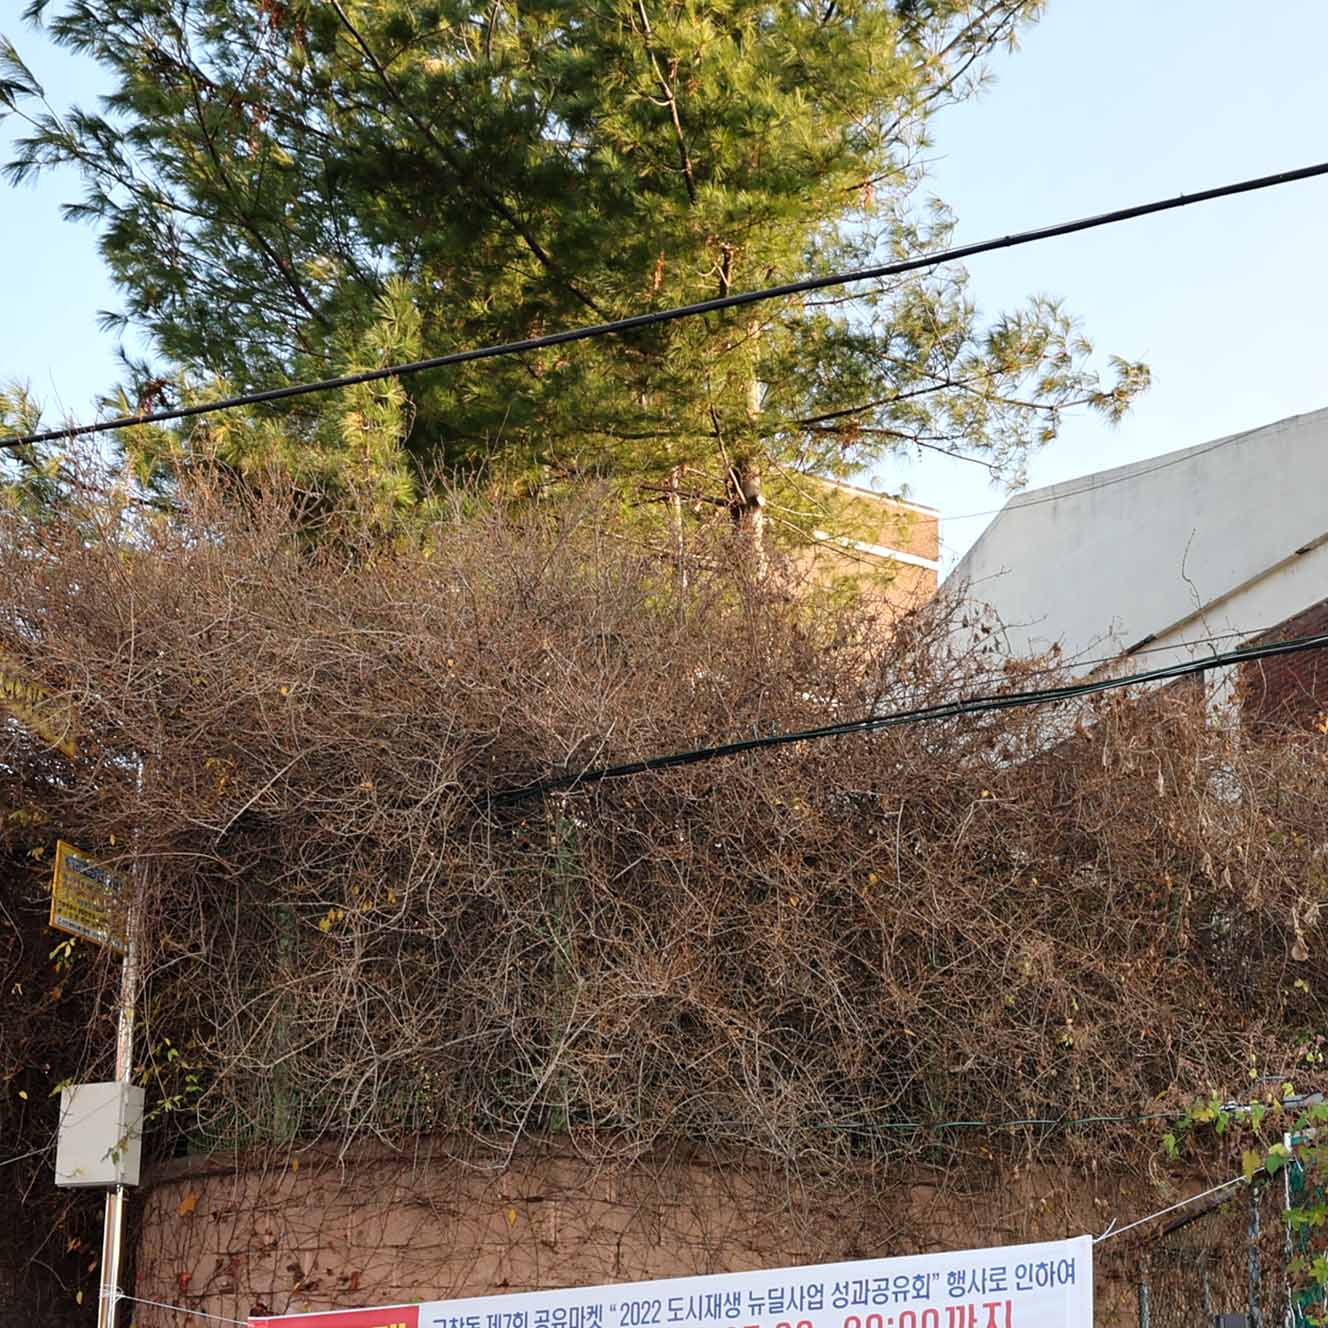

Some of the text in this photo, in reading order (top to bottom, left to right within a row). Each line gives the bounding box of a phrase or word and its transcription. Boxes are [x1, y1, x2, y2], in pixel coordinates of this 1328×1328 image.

[666, 1289, 741, 1323] 도시재생
[747, 1283, 825, 1317] 뉴딜사업
[947, 1266, 1007, 1299] 행사로
[1014, 1257, 1076, 1291] 인하여
